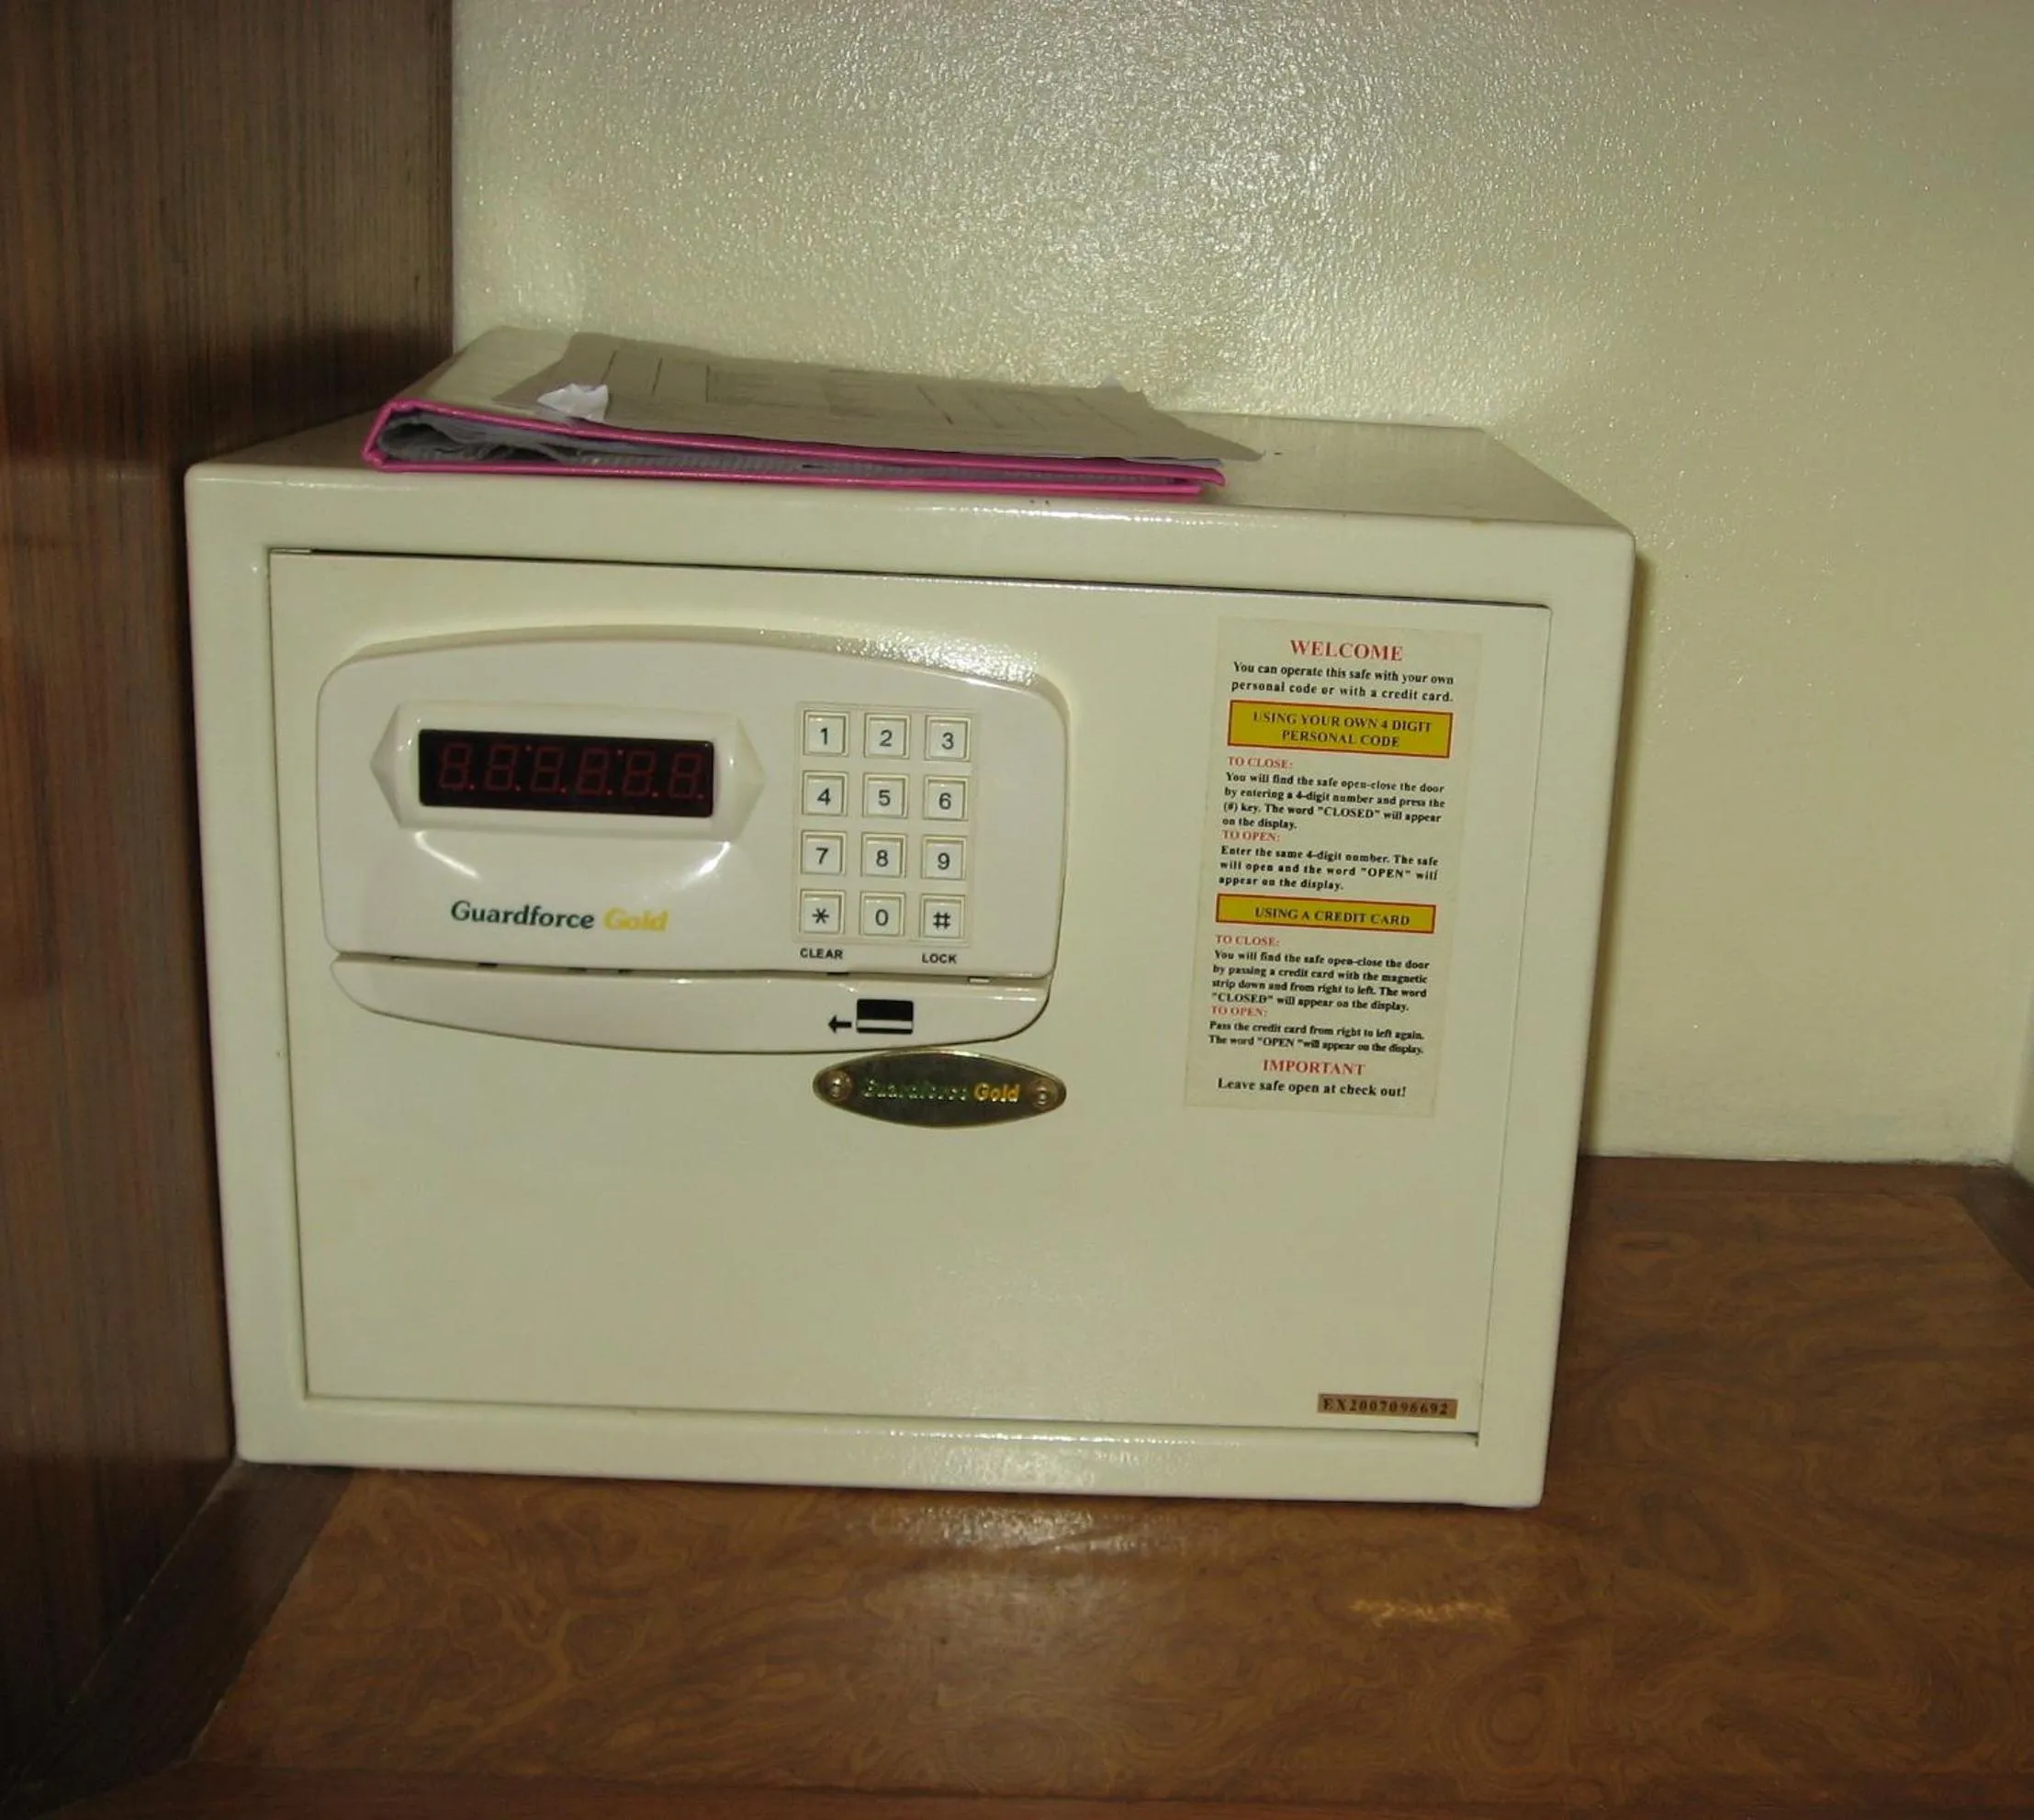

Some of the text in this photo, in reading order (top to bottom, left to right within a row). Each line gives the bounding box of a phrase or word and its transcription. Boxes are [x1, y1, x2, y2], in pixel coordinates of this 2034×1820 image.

[1290, 638, 1404, 661] WELCOME
[1232, 660, 1454, 685] You can operate this safe with your own
[1231, 680, 1453, 702] personal code or with a credit card.
[1253, 711, 1432, 733] USING YOUR OWN 4 DIGIT
[820, 727, 954, 750] 1 2 3
[1281, 728, 1400, 747] PERSONAL CODE
[1228, 755, 1293, 770] TO CLOSE:
[1225, 770, 1444, 793] You will find the safe open-close the door
[817, 788, 952, 810] 4 5 6
[1223, 785, 1445, 808] by entering a 4-digit number and press the
[1221, 816, 1298, 831] on the display.
[1240, 802, 1261, 815] key.
[1264, 802, 1285, 814] The
[1286, 804, 1315, 816] word
[1317, 805, 1380, 819] "CLOSED"
[1382, 810, 1403, 821] will
[1403, 813, 1442, 824] appear
[1222, 828, 1240, 840] TO
[815, 847, 950, 870] 7 8 9
[1219, 844, 1439, 867] Enter the same 4-digit number. The safe
[1219, 859, 1438, 881] will open and the word "OPEN" will
[1218, 875, 1343, 893] appear on the display.
[450, 899, 669, 932] Guardforce Gold
[875, 908, 951, 929] 0 #
[1254, 905, 1410, 926] USING A CREDIT CARD
[1216, 934, 1279, 947] TO CLOSE:
[799, 948, 844, 960] CLEAR
[921, 953, 958, 964] LOCK
[1213, 949, 1431, 970] You will find the safe open-close the door
[1211, 963, 1428, 985] by passing a credit card with the magnetic
[1211, 978, 1236, 991] strip
[1237, 979, 1266, 990] down
[1267, 981, 1288, 991] and
[1288, 981, 1315, 993] from
[1316, 983, 1343, 995] right
[1343, 984, 1355, 994] to
[1377, 985, 1399, 996] The
[1399, 987, 1427, 998] word
[1211, 992, 1410, 1014] "CLOSED" will appear on the display.
[1211, 1005, 1228, 1016] TO
[1208, 1019, 1424, 1041] Pass the credit card from right to left again.
[1208, 1033, 1228, 1044] The
[1229, 1035, 1255, 1046] word
[1320, 1041, 1356, 1052] appear
[1356, 1043, 1370, 1051] on
[1370, 1041, 1387, 1052] the
[1387, 1042, 1423, 1056] display.
[1262, 1058, 1366, 1076] IMPORTANT
[972, 1081, 1020, 1103] Gold
[1217, 1076, 1407, 1097] Leave safe open at check out!
